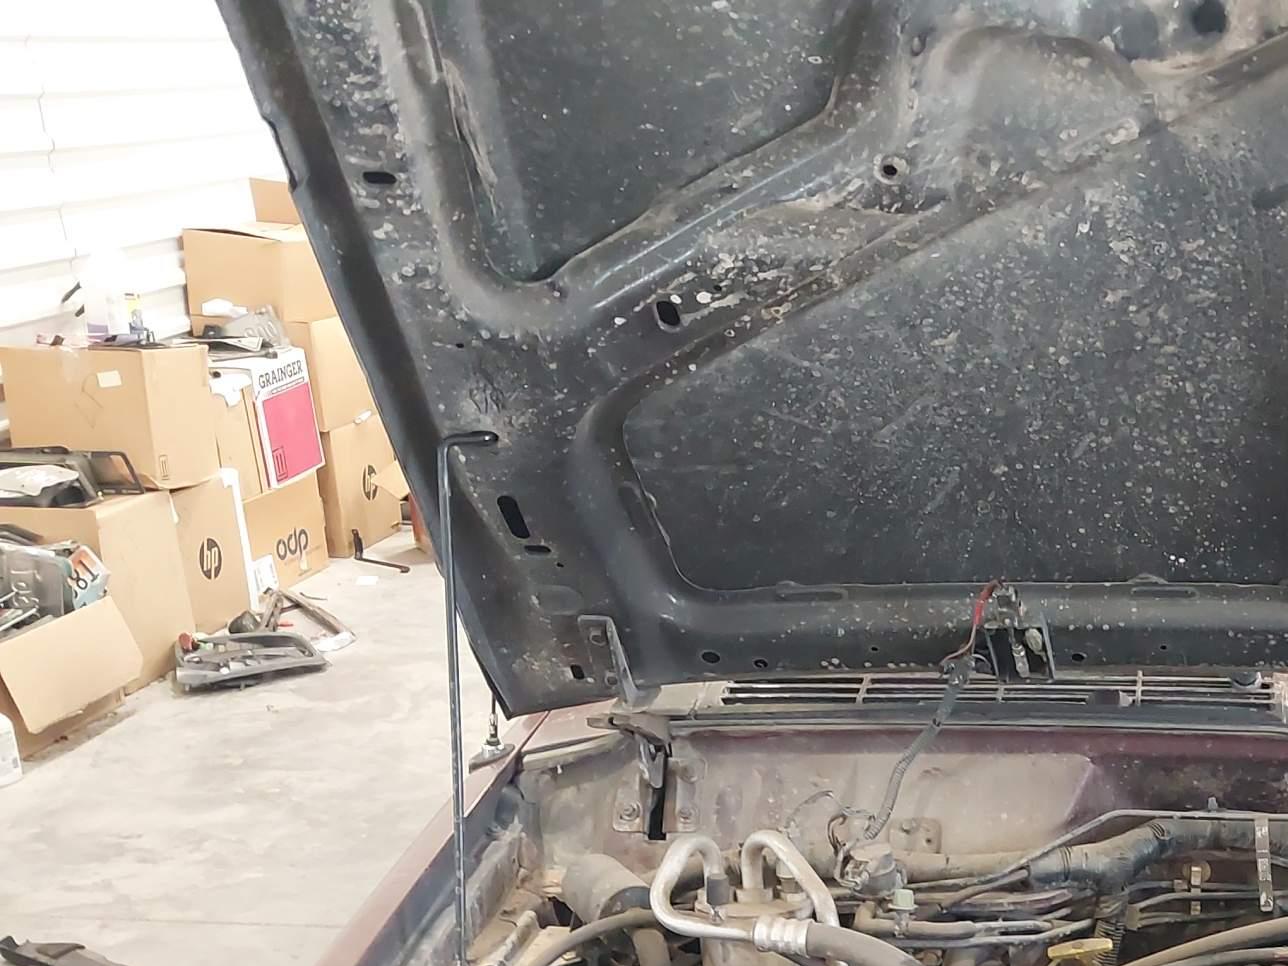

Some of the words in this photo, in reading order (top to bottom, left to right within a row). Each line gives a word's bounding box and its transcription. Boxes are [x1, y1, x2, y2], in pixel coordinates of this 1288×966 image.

[258, 359, 303, 389] GRAINGER
[200, 538, 222, 580] hp
[276, 527, 309, 560] odp
